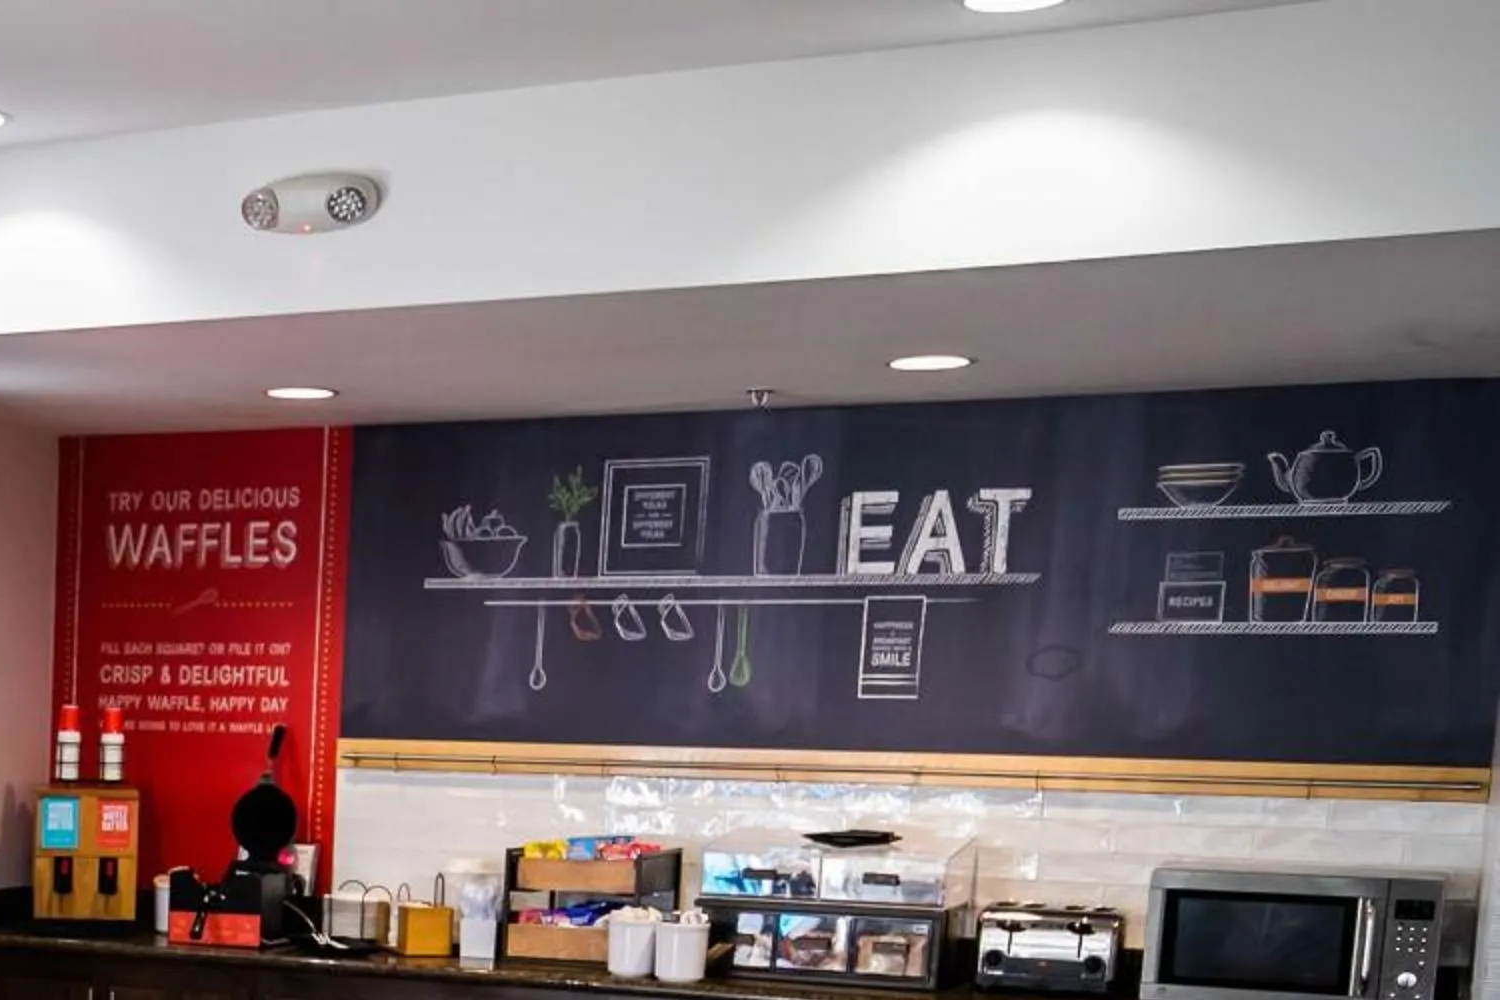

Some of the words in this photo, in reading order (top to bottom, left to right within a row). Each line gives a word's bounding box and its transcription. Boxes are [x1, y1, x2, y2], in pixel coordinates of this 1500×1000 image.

[108, 491, 144, 513] TRY
[151, 489, 192, 512] OUR
[200, 486, 300, 511] DELICIOUS
[838, 488, 1032, 575] EAT
[107, 520, 298, 570] WAFFLES
[871, 652, 911, 667] SMILE
[100, 664, 153, 684] CRISP
[160, 664, 172, 685] &
[179, 665, 291, 687] DELIGHTFUL
[98, 695, 142, 709] HAPPY
[147, 695, 206, 712] WAFFLE,
[209, 697, 256, 712] HAPPY
[261, 697, 290, 713] DAY
